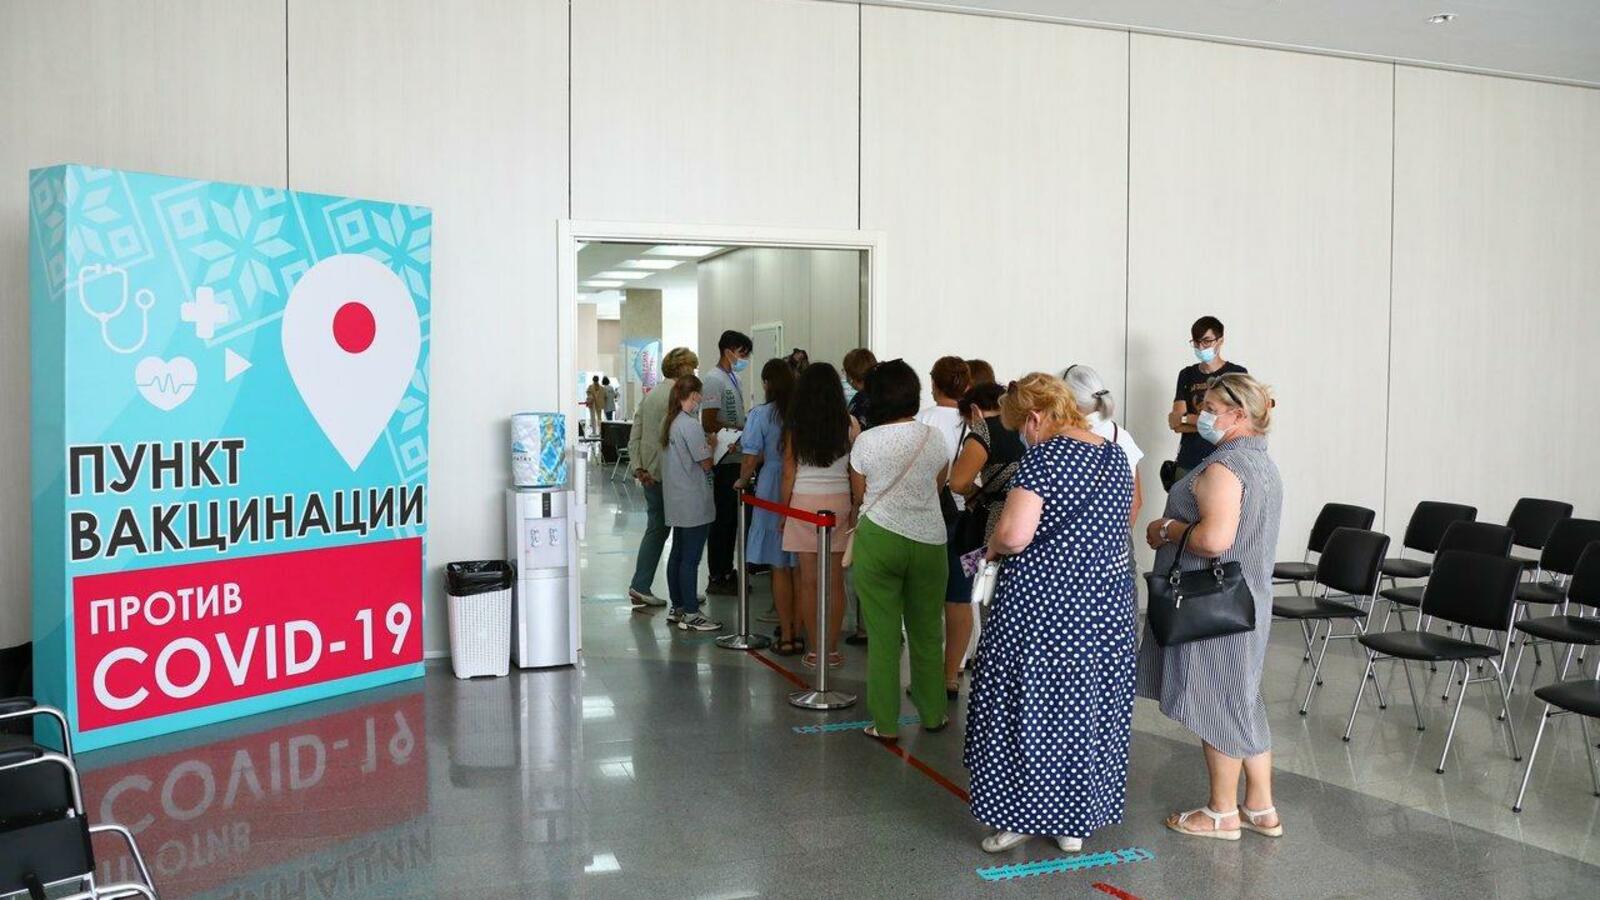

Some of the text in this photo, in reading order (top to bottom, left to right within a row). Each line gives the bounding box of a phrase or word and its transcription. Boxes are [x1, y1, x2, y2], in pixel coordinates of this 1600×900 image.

[69, 439, 245, 495] ПУНКТ
[70, 485, 424, 561] ВАКЦИНАЦИИ
[90, 582, 242, 635] ПРОТИВ
[93, 602, 412, 710] COVID-19
